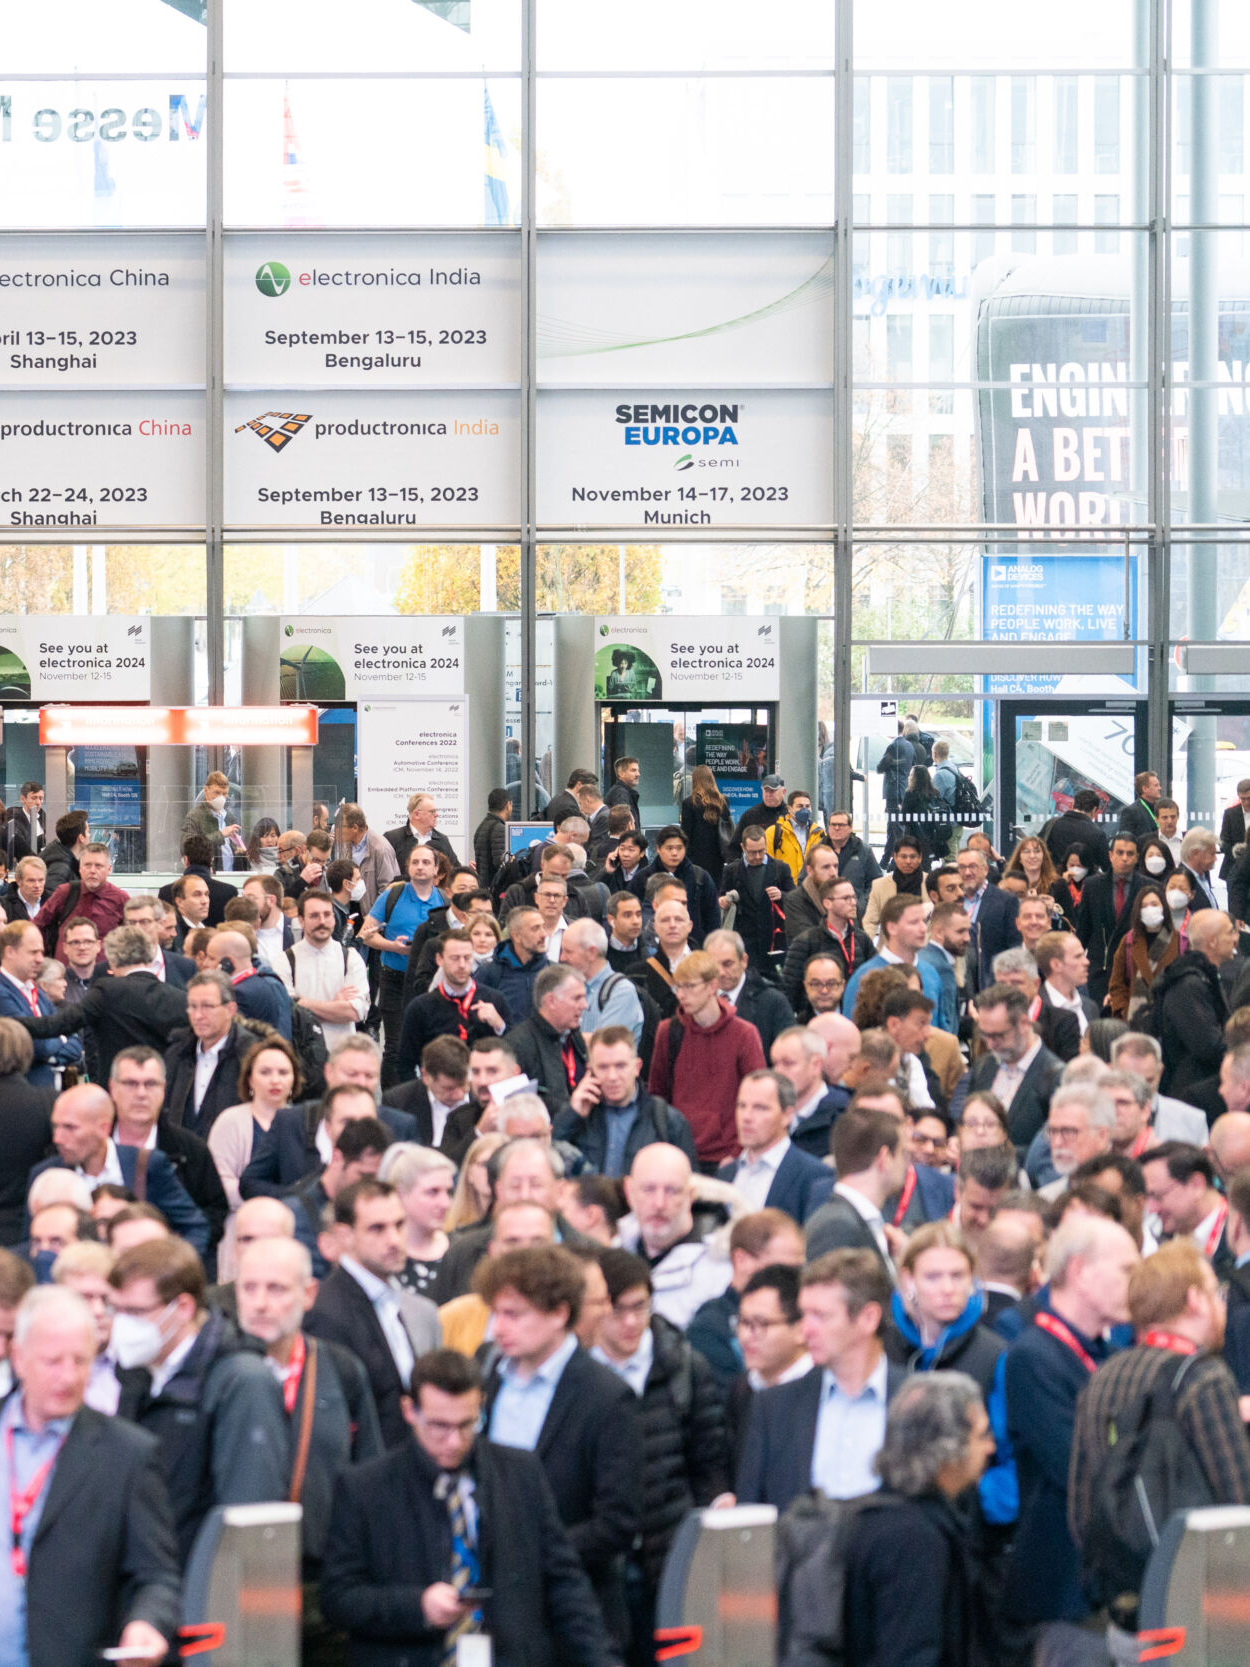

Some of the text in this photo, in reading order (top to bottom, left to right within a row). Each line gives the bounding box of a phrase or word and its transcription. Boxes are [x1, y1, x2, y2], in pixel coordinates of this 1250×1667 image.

[110, 269, 169, 286] China
[299, 268, 480, 286] electronica India
[89, 331, 137, 345] 2023
[265, 330, 369, 347] September
[439, 330, 486, 344] 2023
[11, 353, 96, 371] Shanghai
[326, 353, 421, 370] Bengaluru
[615, 404, 738, 423] SEMICON
[1, 419, 191, 440] productronica China
[316, 419, 499, 439] productronica India
[625, 426, 738, 446] EUROPA
[1012, 428, 1039, 482] A
[698, 459, 739, 467] semi
[100, 488, 147, 502] 2023
[258, 488, 362, 505] September
[431, 487, 478, 501] 2023
[572, 487, 671, 501] November
[741, 487, 788, 501] 2023
[9, 510, 98, 526] Shanghai
[321, 511, 416, 525] Bengaluru
[645, 509, 710, 524] Munich
[1007, 565, 1043, 573] ANALOG
[1007, 573, 1044, 581] DEVICES
[991, 604, 1124, 616] REDEFINING THE WAY
[990, 618, 1117, 631] PEOPLE WORK, LIVE
[40, 643, 108, 655] See you at
[355, 644, 422, 656] See you at
[671, 643, 739, 656] See you at
[39, 657, 145, 668] electronica 2024
[354, 658, 459, 668] electronica 2024
[671, 658, 774, 668] electronica 2024
[40, 672, 111, 680] November 12-15
[354, 673, 402, 681] November
[670, 672, 742, 680] November 12-15
[990, 684, 1010, 693] Hall
